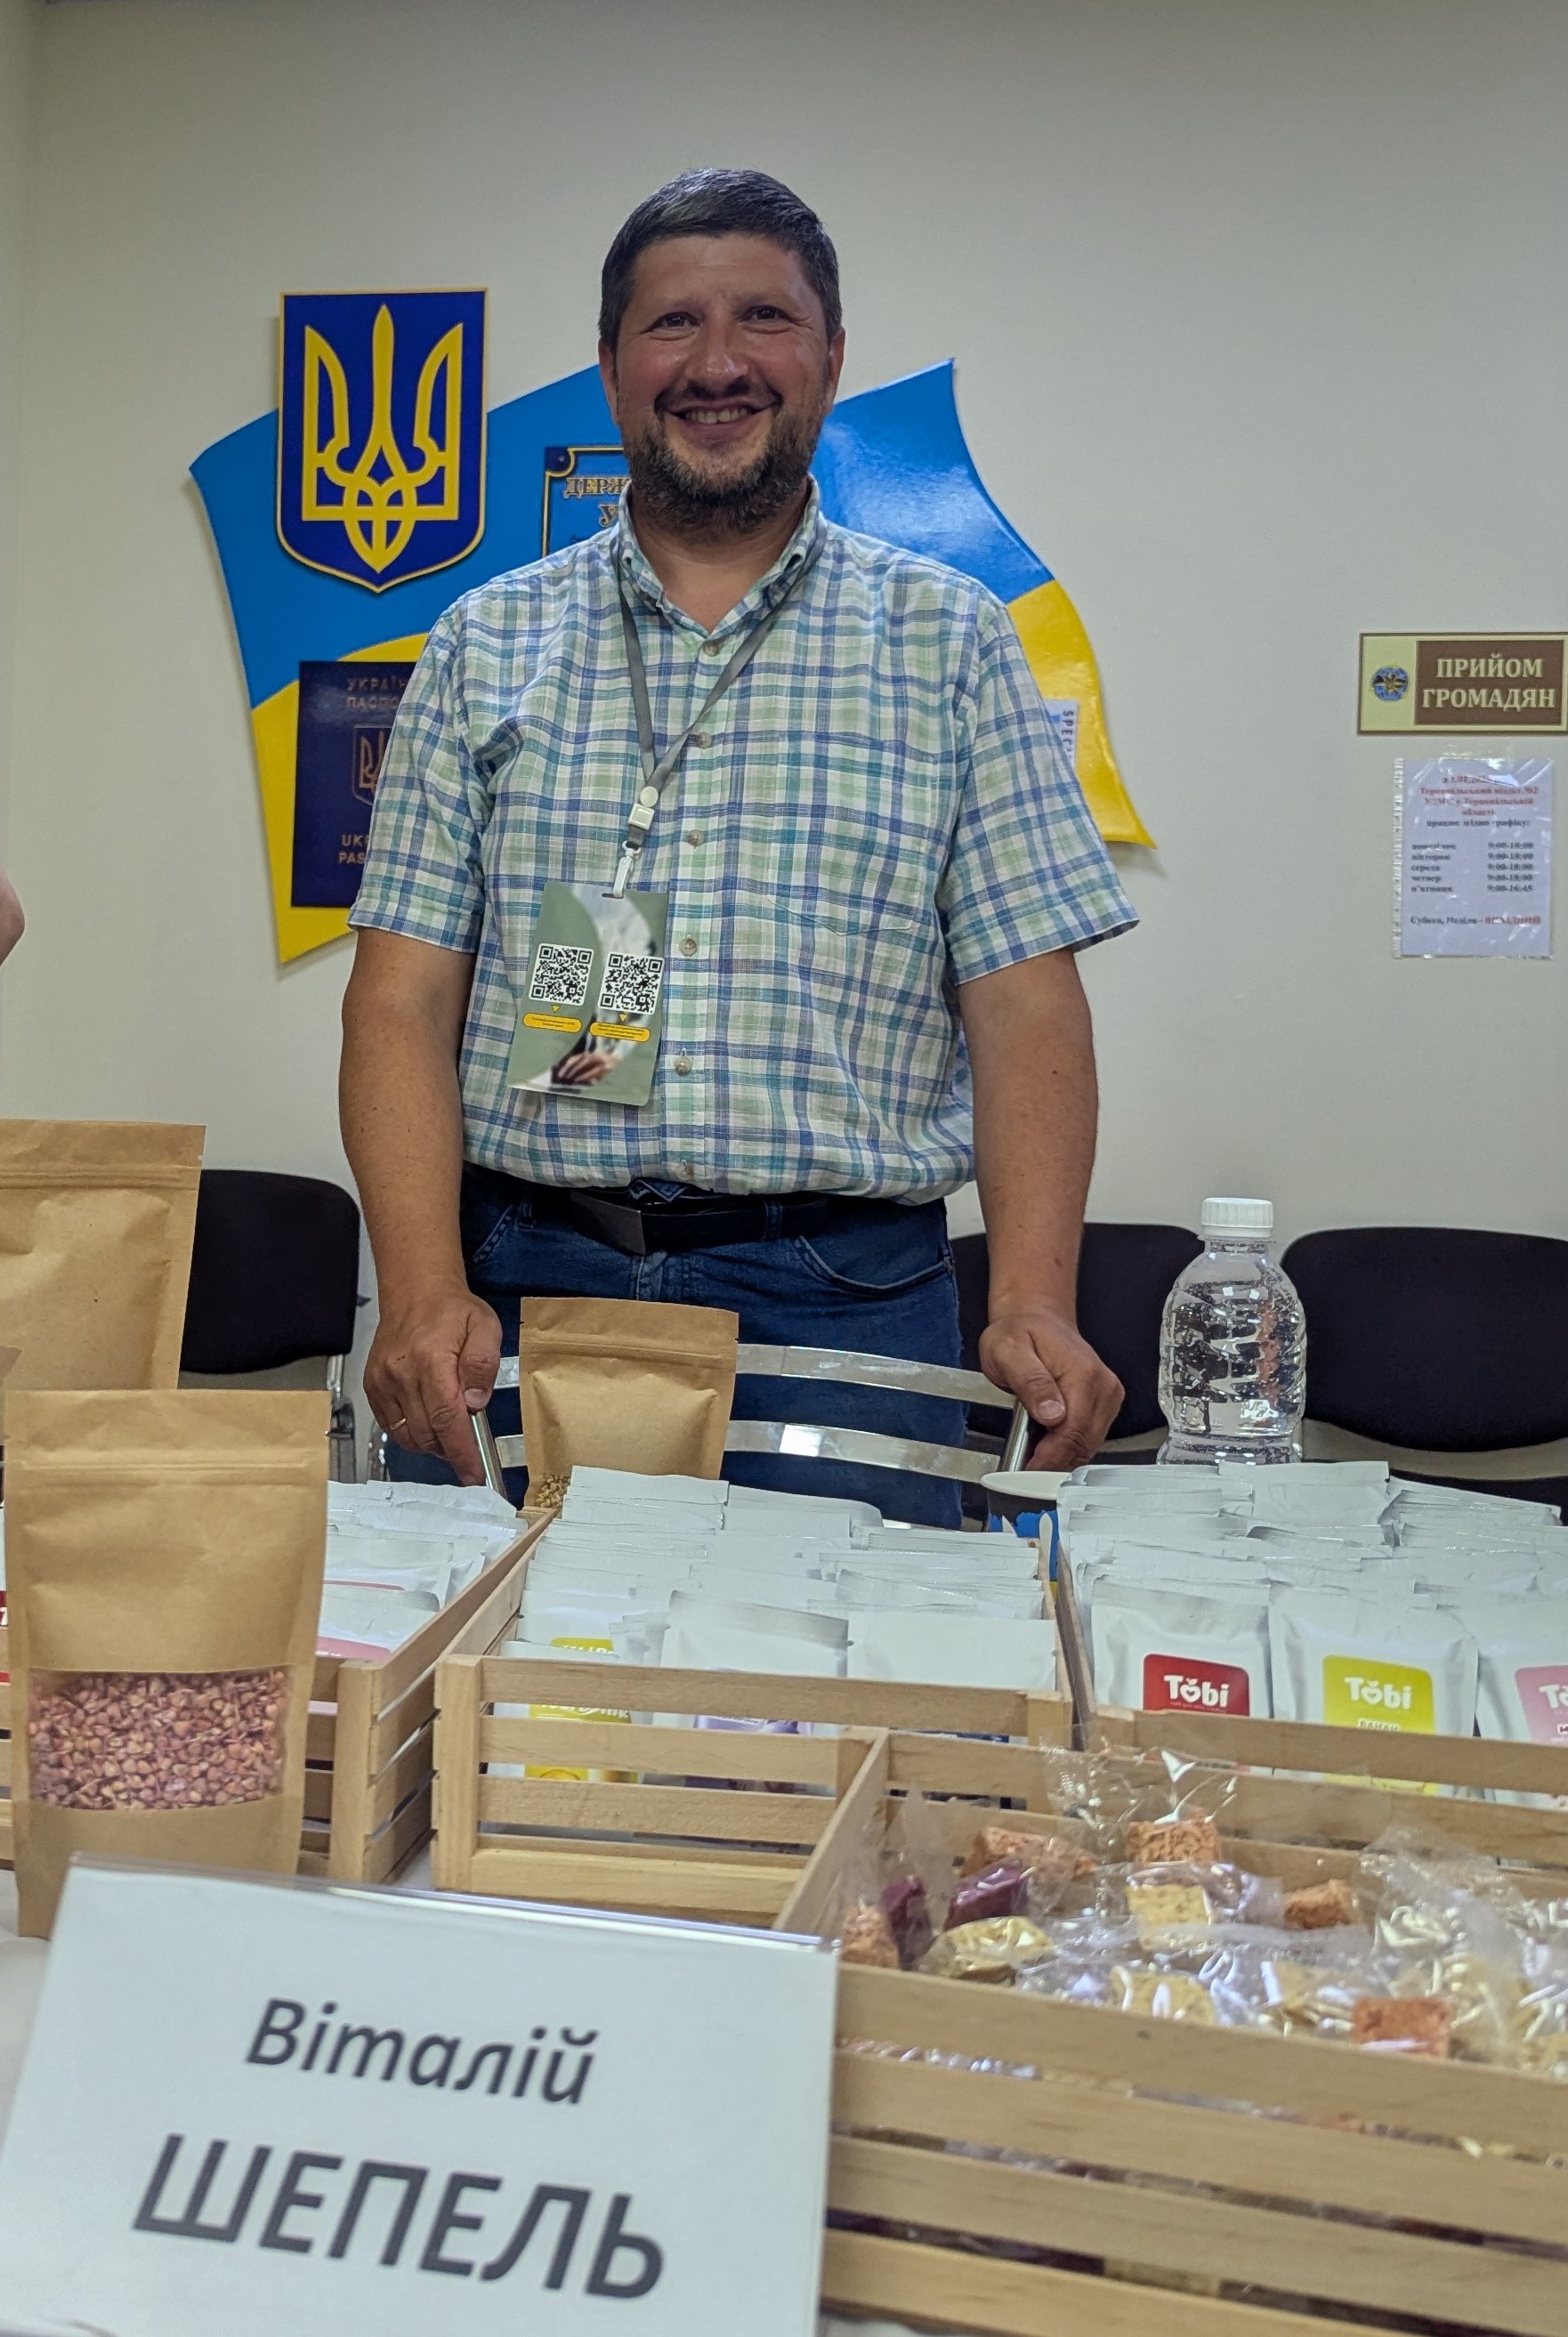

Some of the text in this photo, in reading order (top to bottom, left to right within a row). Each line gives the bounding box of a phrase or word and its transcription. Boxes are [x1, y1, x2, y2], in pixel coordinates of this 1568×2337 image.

[1436, 651, 1542, 678] ПРИЙОМ
[1422, 688, 1556, 712] ГРОМАДЯН
[1163, 1675, 1230, 1708] Tobi
[1344, 1676, 1413, 1710] Tobi
[247, 1998, 598, 2104] Віталій
[133, 2134, 665, 2301] ШЕПЕЛЬ
